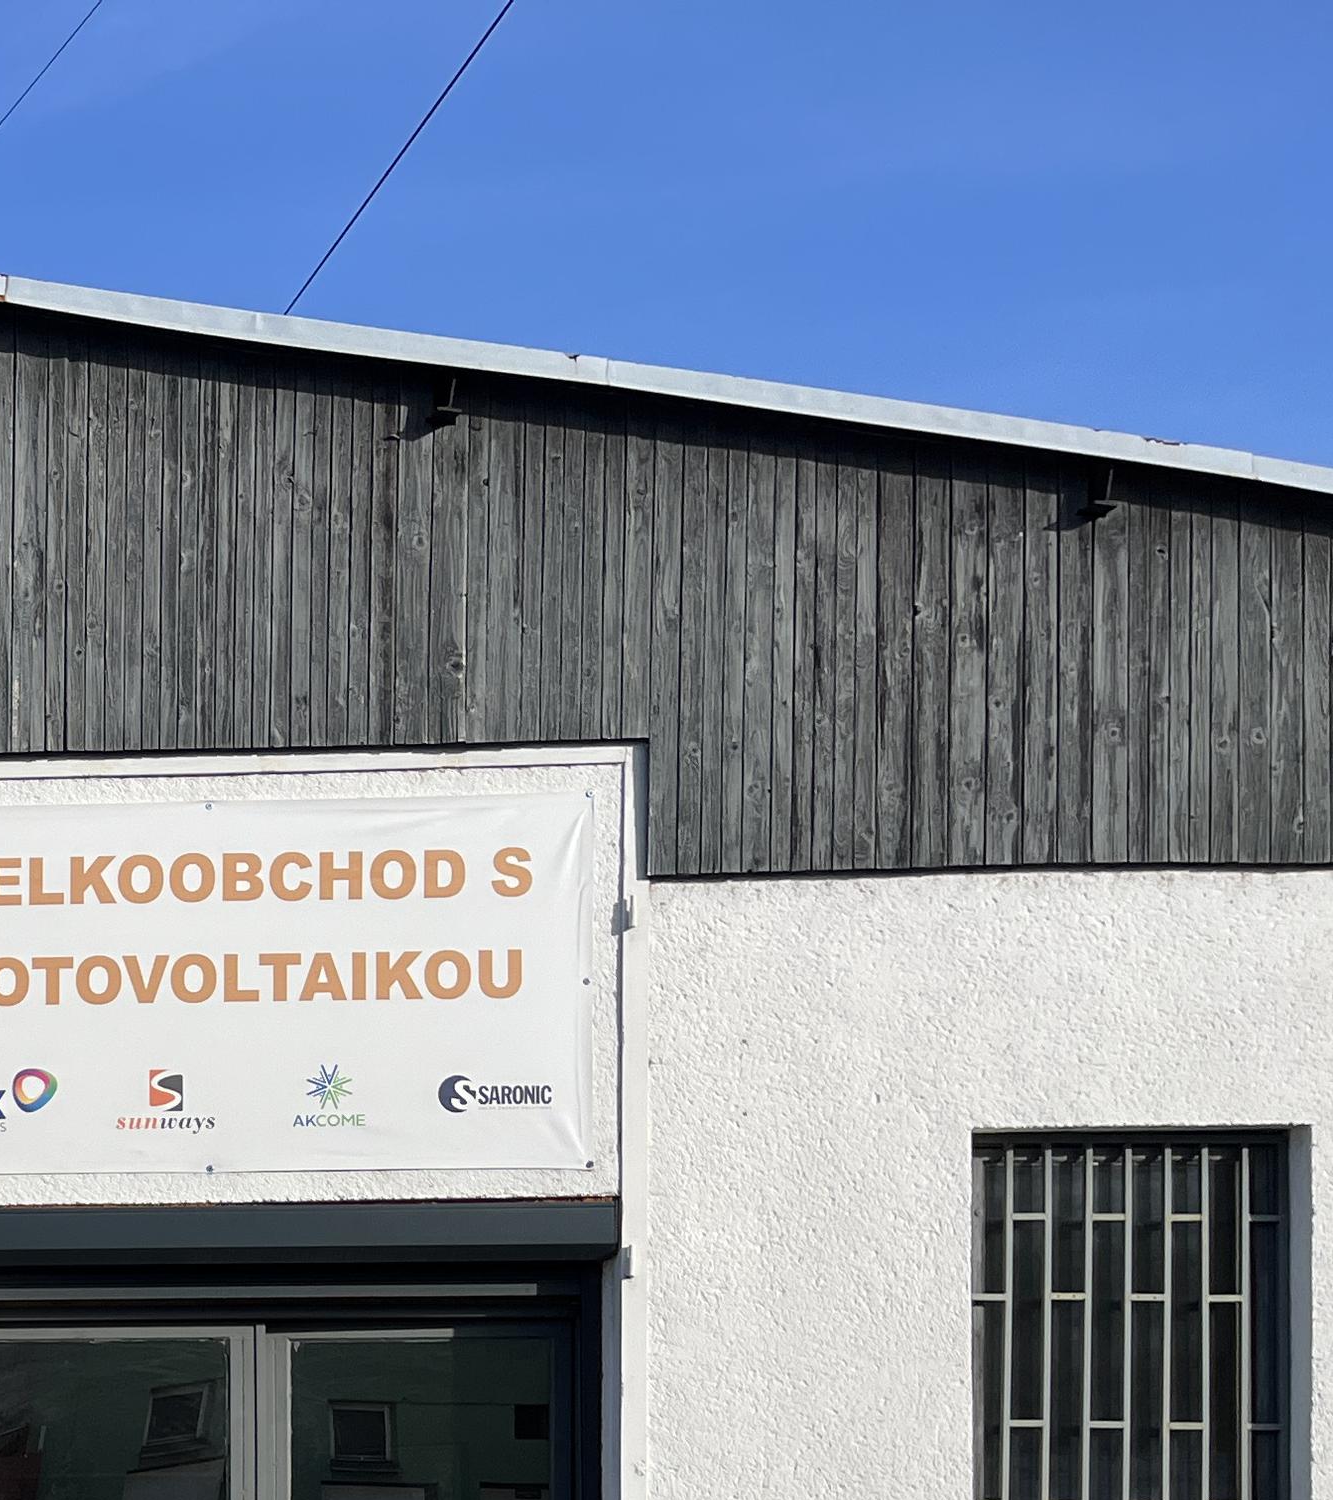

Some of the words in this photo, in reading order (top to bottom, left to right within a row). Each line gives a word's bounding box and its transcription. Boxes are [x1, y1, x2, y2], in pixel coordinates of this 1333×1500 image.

[491, 846, 533, 898] S
[477, 1085, 553, 1105] SARONIC
[116, 1115, 216, 1135] sunways
[292, 1113, 366, 1128] AKCOME
